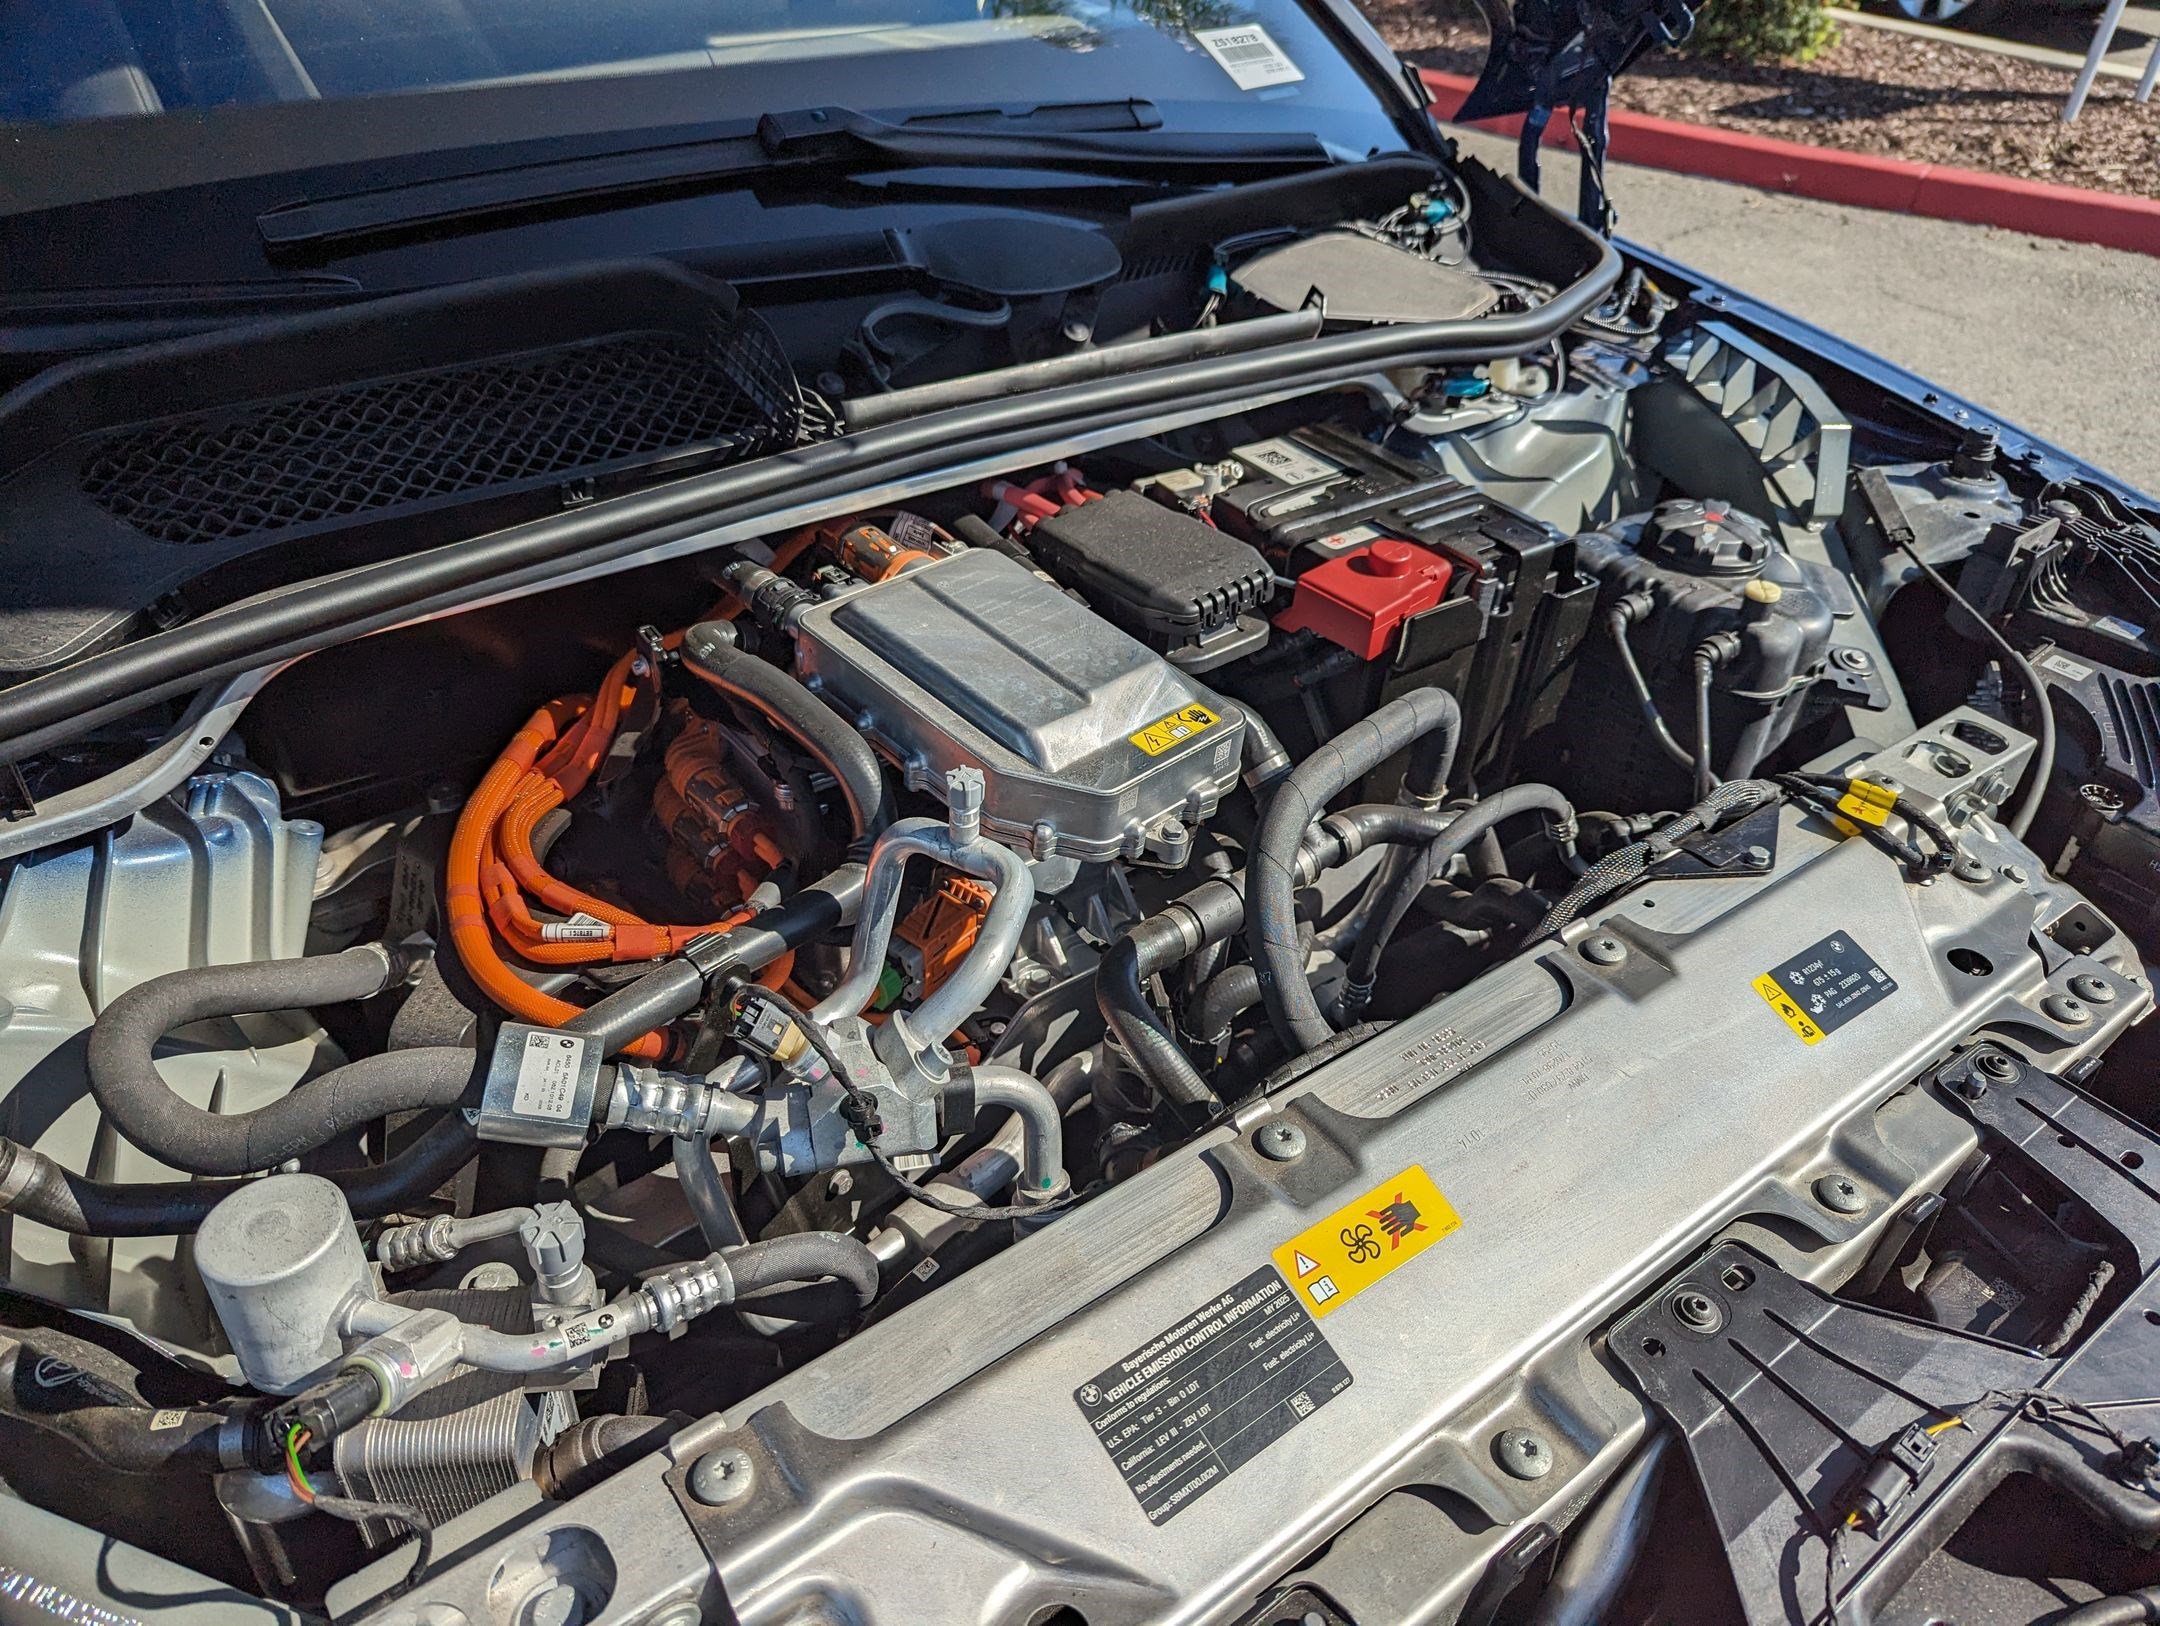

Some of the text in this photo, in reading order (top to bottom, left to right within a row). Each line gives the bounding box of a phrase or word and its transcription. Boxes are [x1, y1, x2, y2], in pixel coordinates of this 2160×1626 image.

[1824, 987, 1837, 999] PAG
[1264, 1294, 1290, 1315] MY 2025
[1104, 1280, 1282, 1402] VEHICLE EMISSION CONTROL INFORMATION
[1121, 1294, 1234, 1372] Bayerische Motoren Werke AG
[1248, 1312, 1300, 1350] Fuel: electricity Li+
[1263, 1332, 1314, 1370] Fuel: electricity Li+
[1095, 1377, 1171, 1429] Conforms to regulations:
[1106, 1436, 1123, 1448] U.S.
[1122, 1424, 1140, 1438] EPA:
[1140, 1412, 1155, 1424] Tier
[1155, 1407, 1162, 1415] 3
[1167, 1396, 1180, 1406] Bin
[1185, 1380, 1199, 1394] LDT
[1121, 1445, 1155, 1470] California:
[1155, 1432, 1169, 1447] LEV
[1169, 1427, 1178, 1436] III
[1182, 1413, 1197, 1427] ZEV
[1196, 1403, 1211, 1417] LDT
[1135, 1440, 1207, 1494] No adjustments needed.
[1148, 1500, 1173, 1520] Group:
